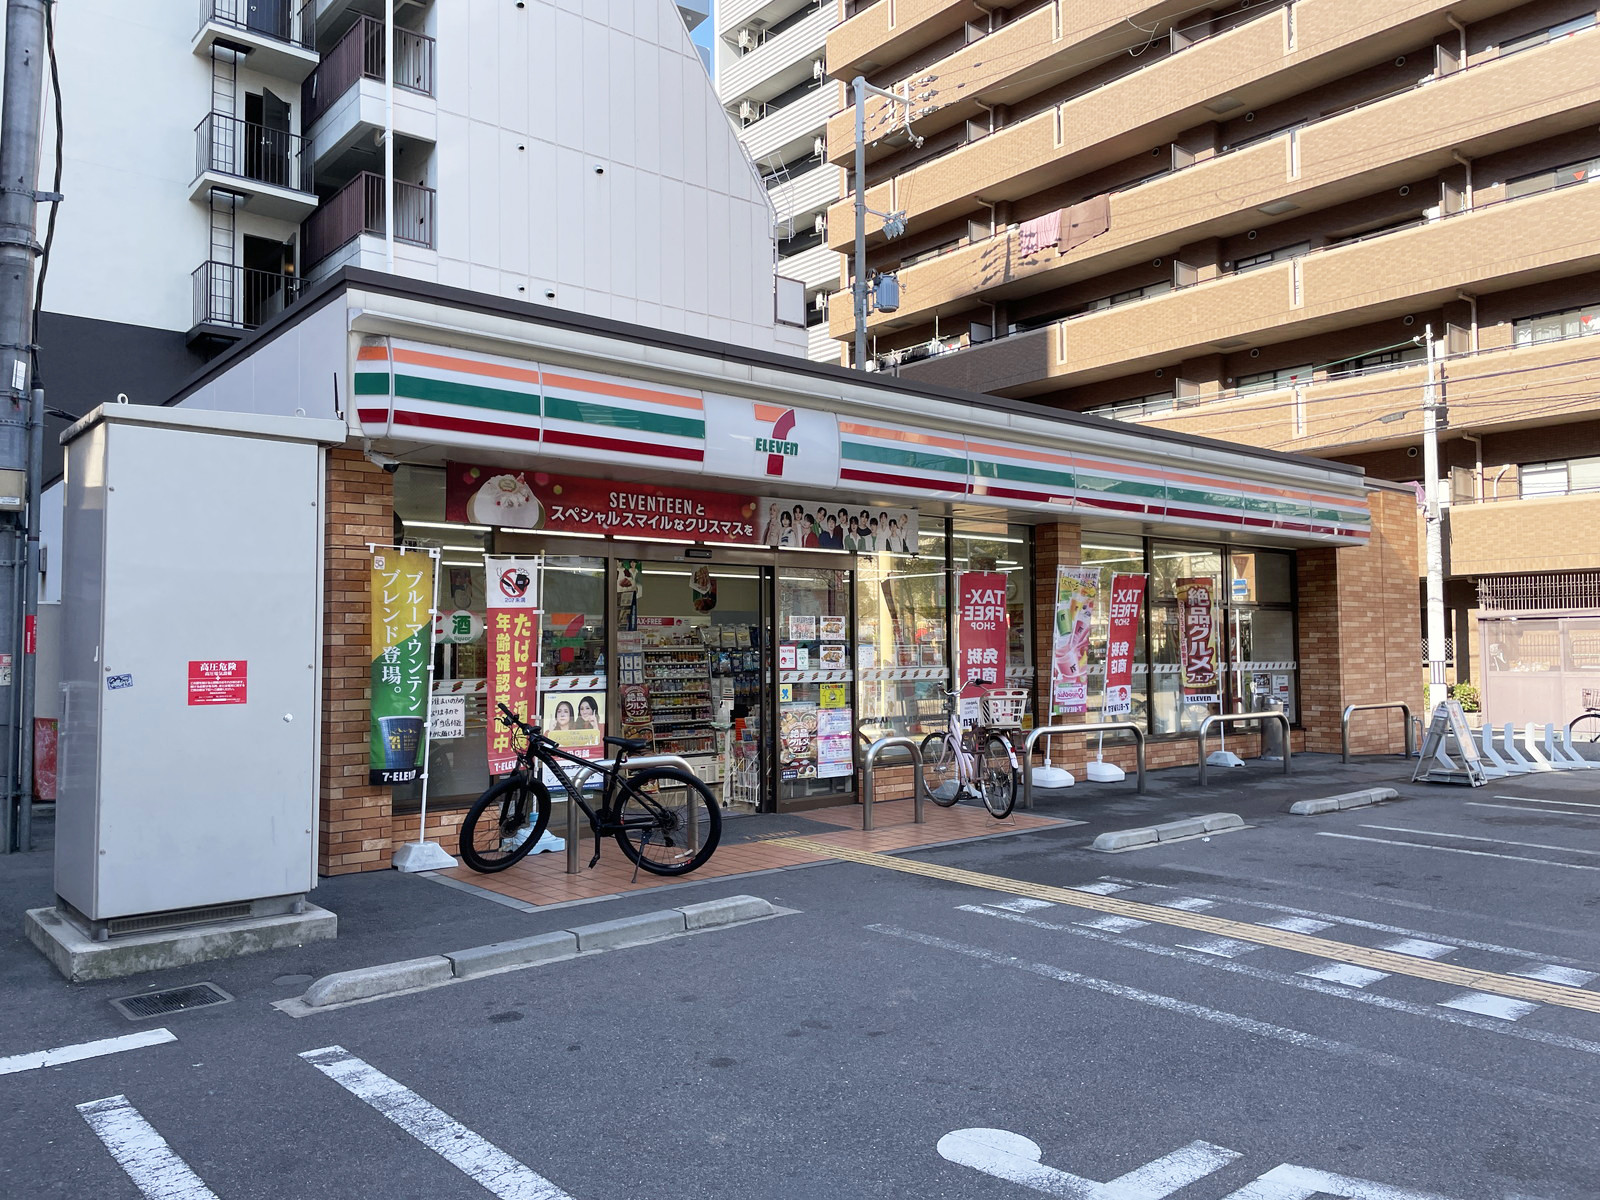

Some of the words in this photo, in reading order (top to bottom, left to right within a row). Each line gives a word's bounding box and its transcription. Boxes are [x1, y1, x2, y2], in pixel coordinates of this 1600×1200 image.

[551, 505, 753, 536] スペシャルスマイルなクリスマスを
[381, 569, 402, 694] ブレンド登場。
[452, 614, 471, 635] 酒
[406, 570, 424, 711] ブルーマウンテン
[200, 662, 236, 671] 高圧危険
[1186, 672, 1214, 683] フェア
